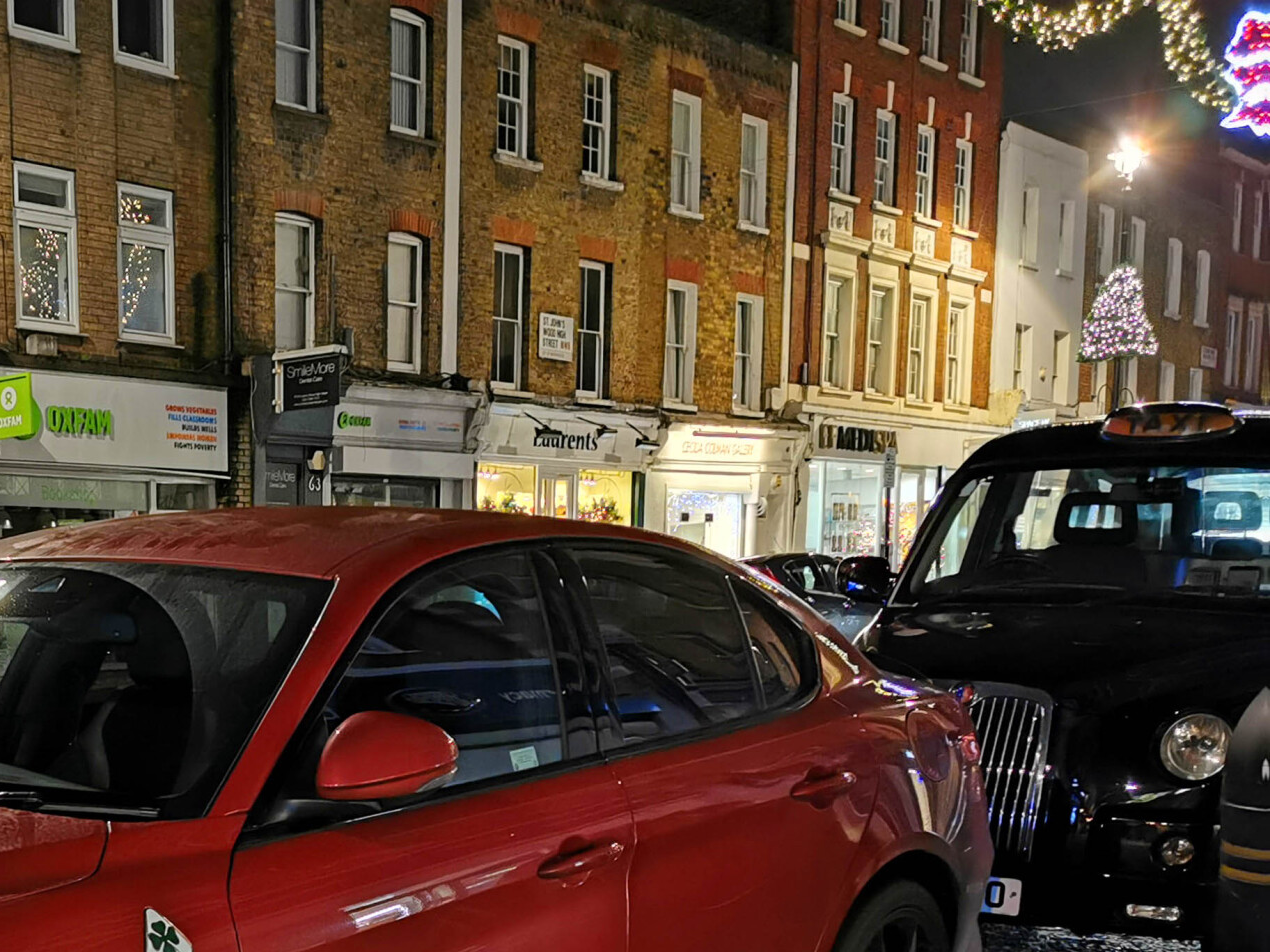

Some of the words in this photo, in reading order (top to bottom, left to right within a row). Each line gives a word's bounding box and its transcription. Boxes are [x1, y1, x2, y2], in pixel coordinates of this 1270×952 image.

[543, 328, 556, 337] WOOD
[543, 338, 558, 348] STREET
[286, 361, 336, 379] SmileMore
[47, 405, 112, 435] OXFAM
[194, 443, 217, 451] POVERTY
[309, 475, 321, 491] 63
